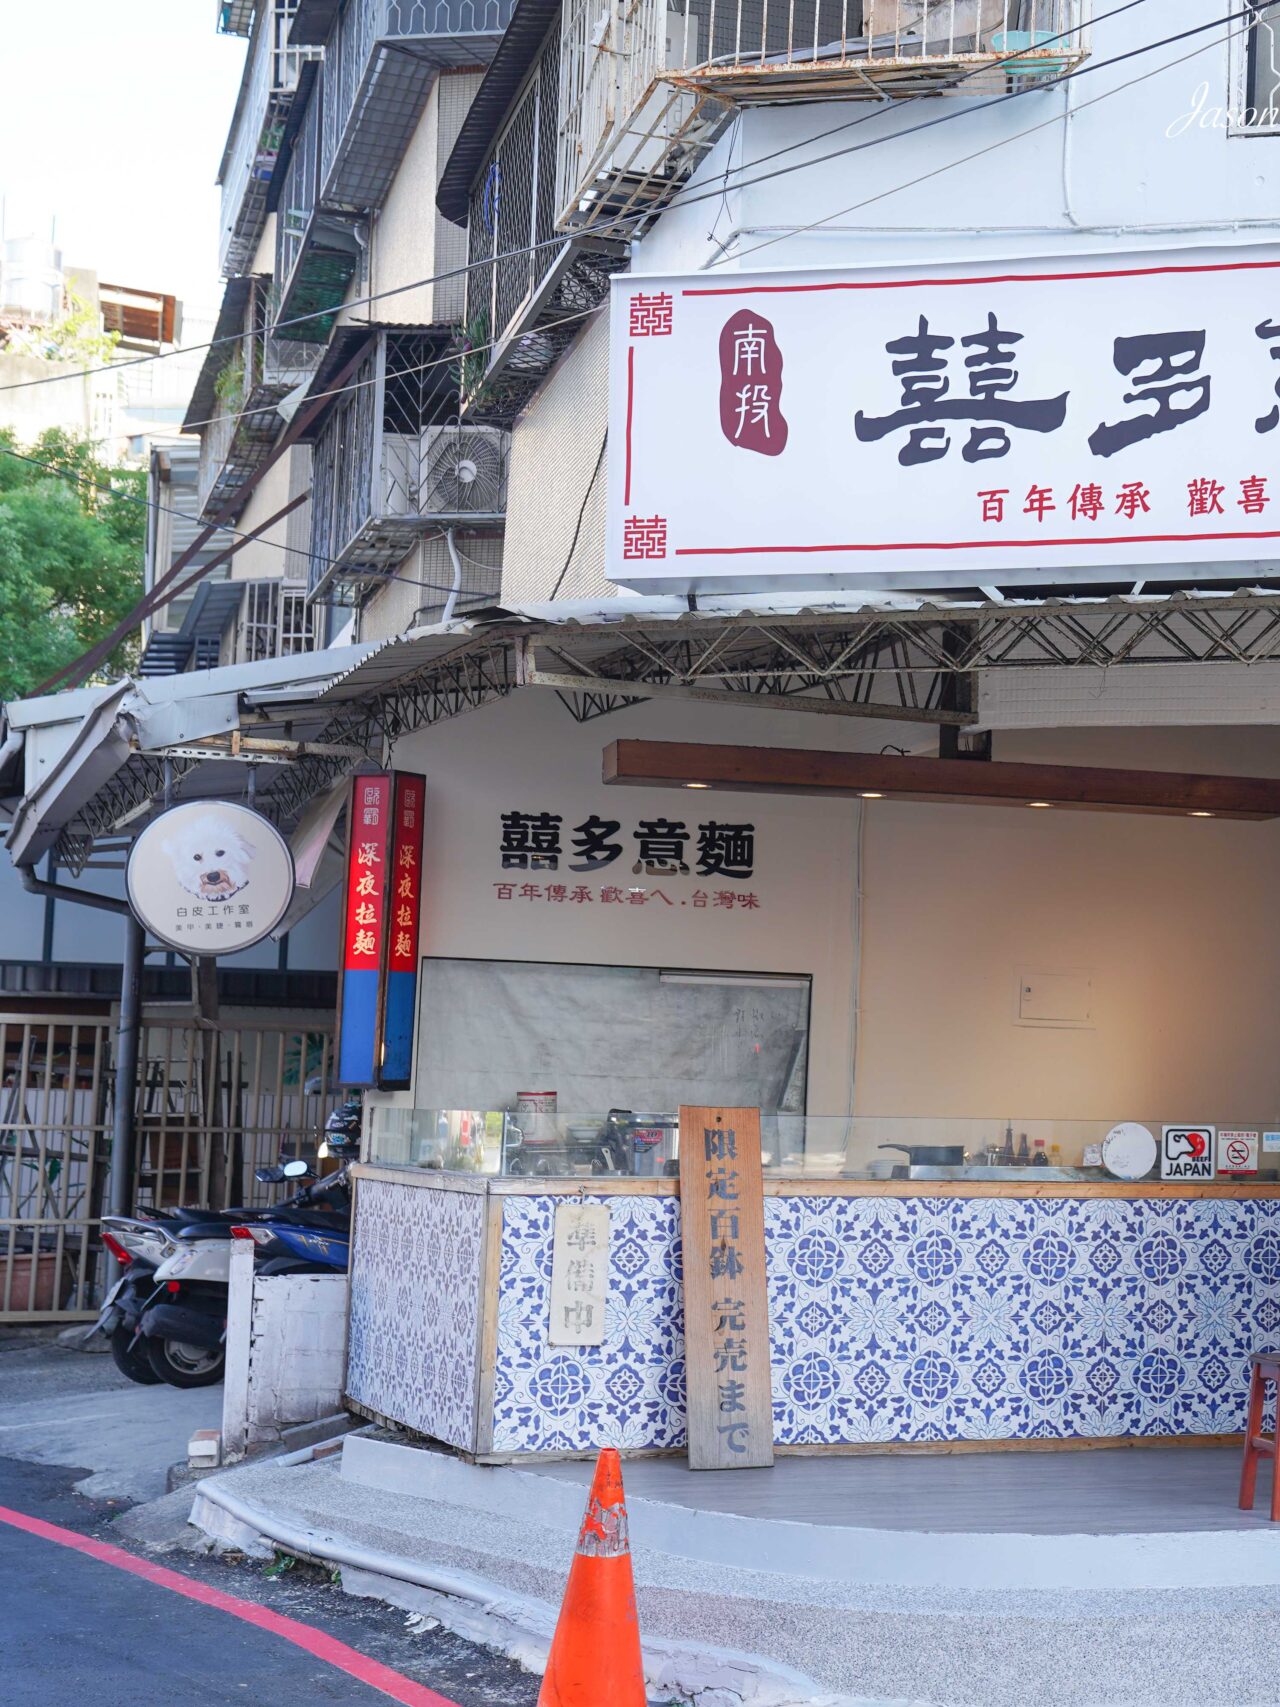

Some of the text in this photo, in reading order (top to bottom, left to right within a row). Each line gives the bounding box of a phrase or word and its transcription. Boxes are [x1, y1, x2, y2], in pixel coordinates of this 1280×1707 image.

[732, 323, 771, 440] 南投
[977, 482, 1152, 524] 百年傳承
[500, 811, 755, 879] 囍多意麵
[176, 904, 250, 918] 白皮工作室
[353, 843, 381, 956] 深夜拉麵
[395, 845, 416, 957] 深夜拉麵
[493, 883, 594, 903] 百年傳承
[1165, 1163, 1212, 1177] JAPAN
[710, 1297, 750, 1454] 完売まで
